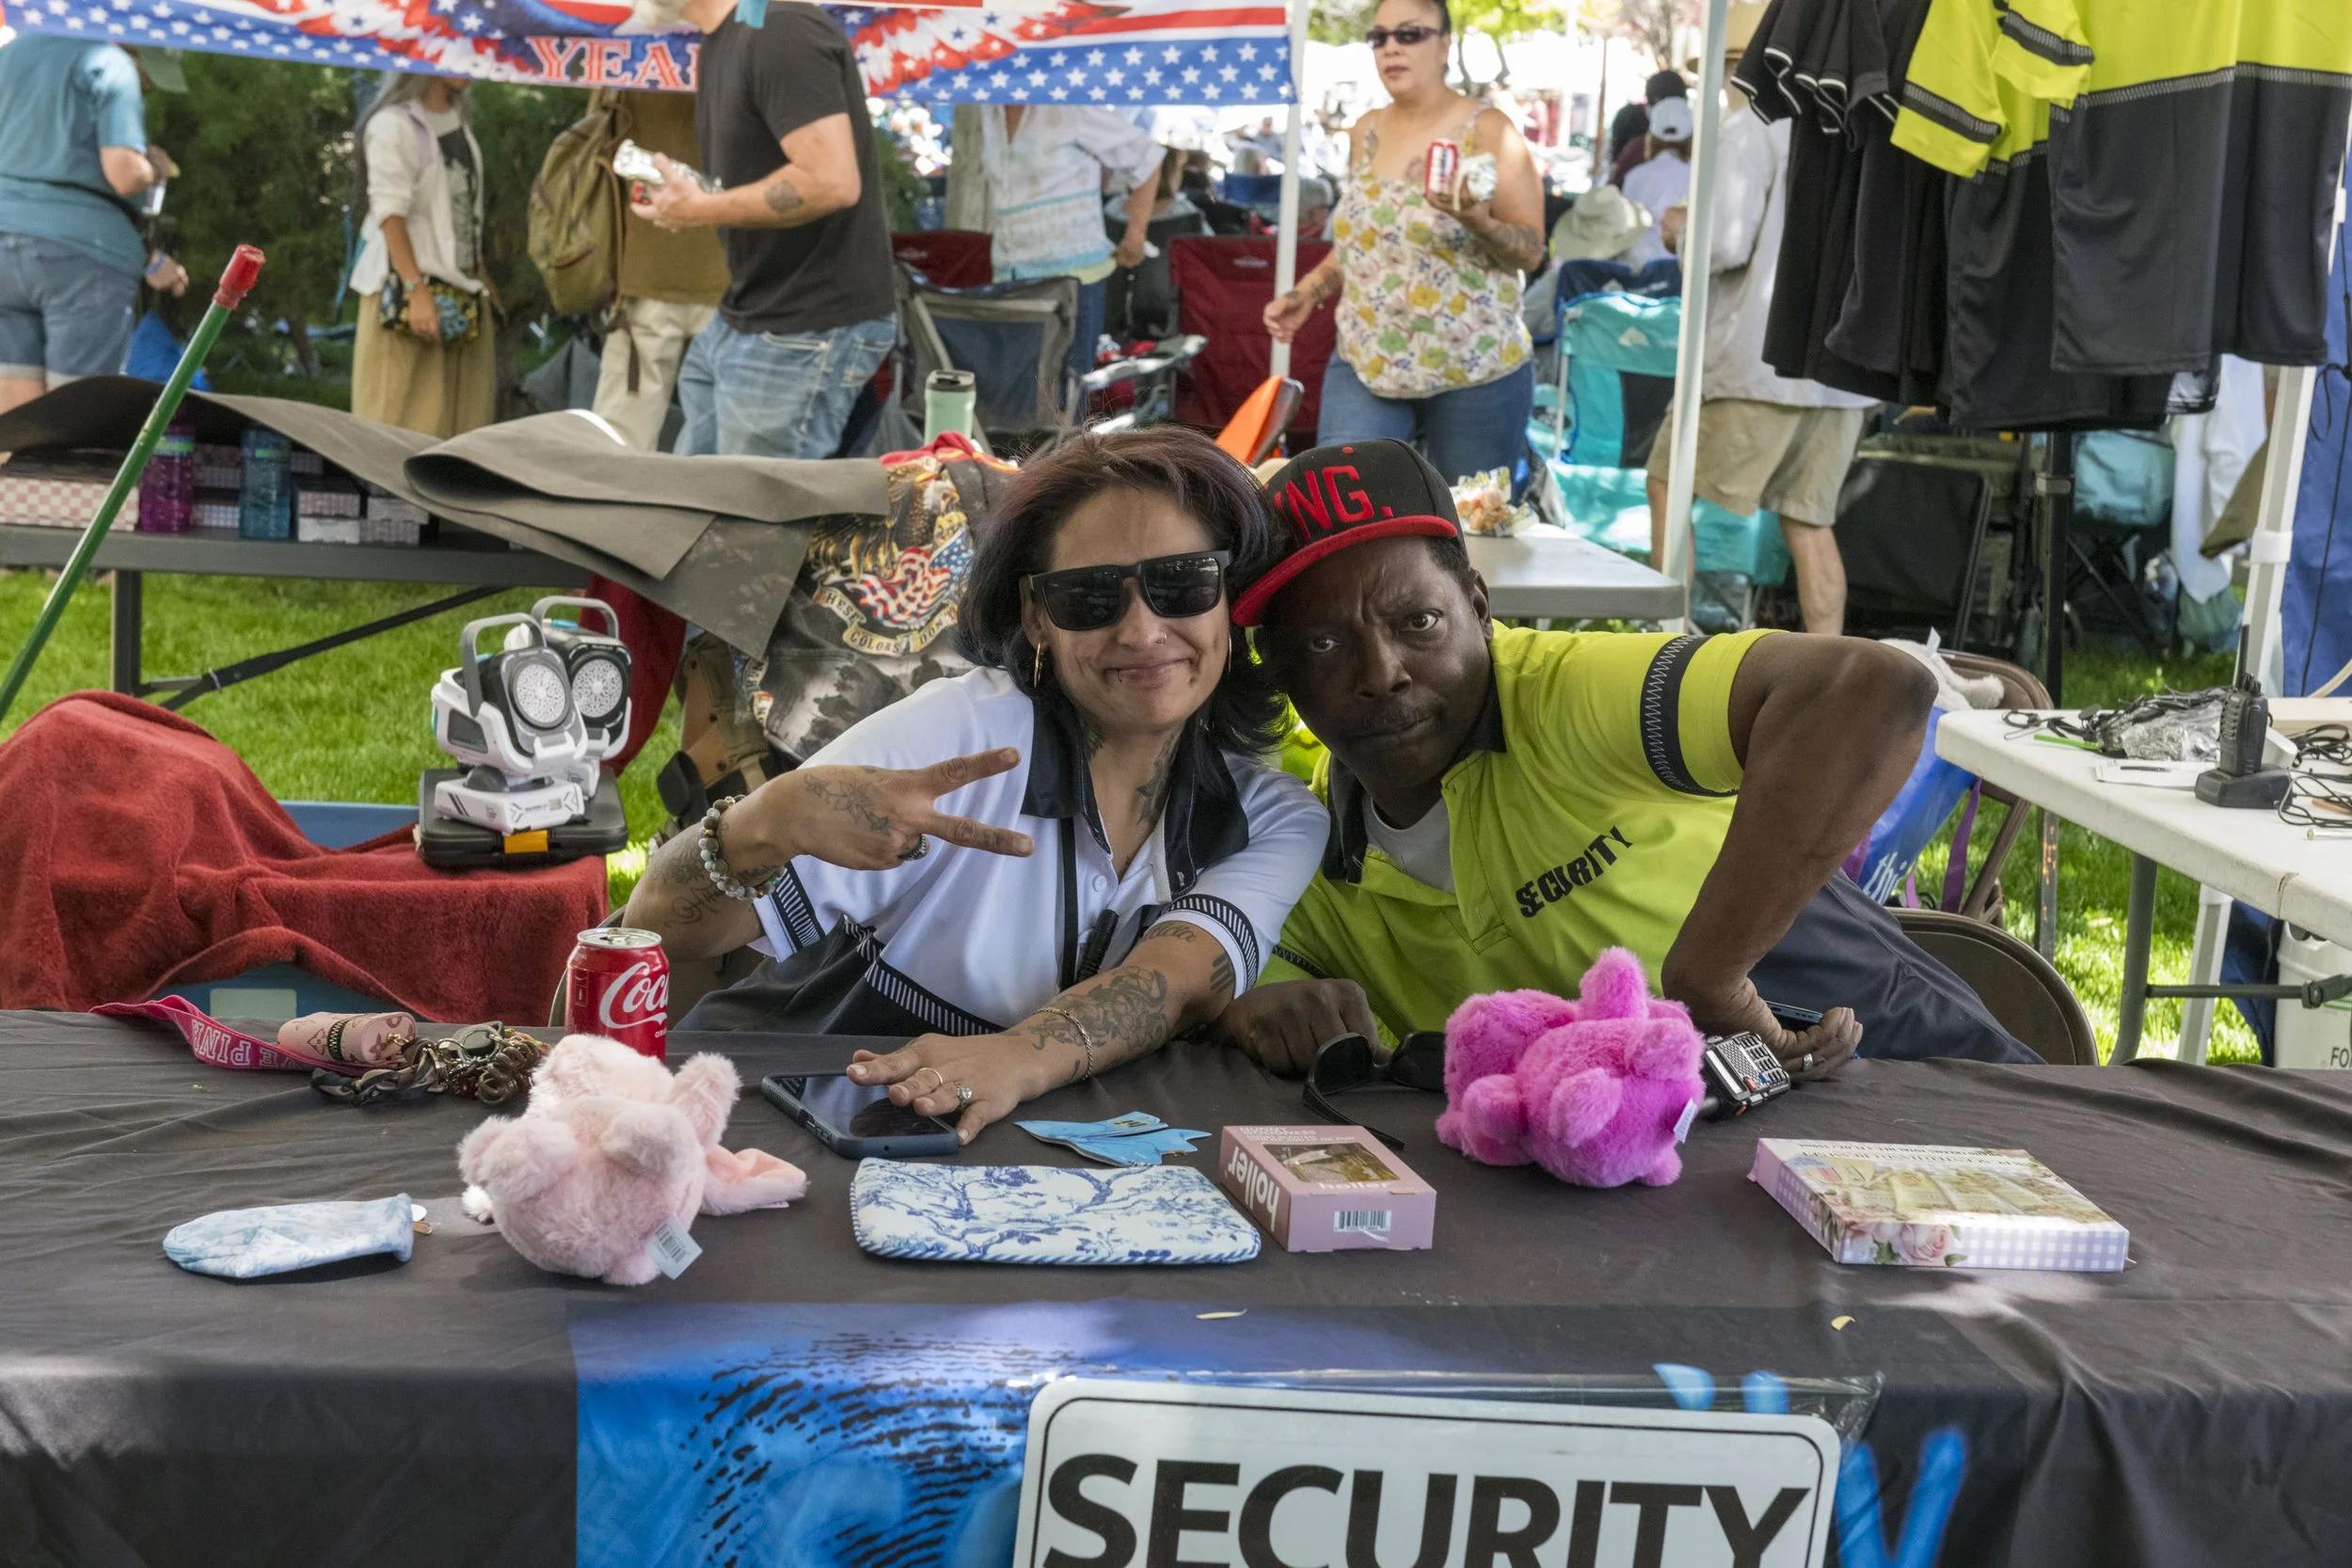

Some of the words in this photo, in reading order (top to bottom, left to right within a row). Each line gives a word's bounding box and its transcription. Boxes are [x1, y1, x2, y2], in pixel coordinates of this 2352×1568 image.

[850, 631, 901, 654] COLORS
[1516, 825, 1633, 918] SECURITY
[1227, 1146, 1280, 1232] holler
[1317, 1181, 1390, 1191] holler
[1042, 1453, 1812, 1568] SECURITY
